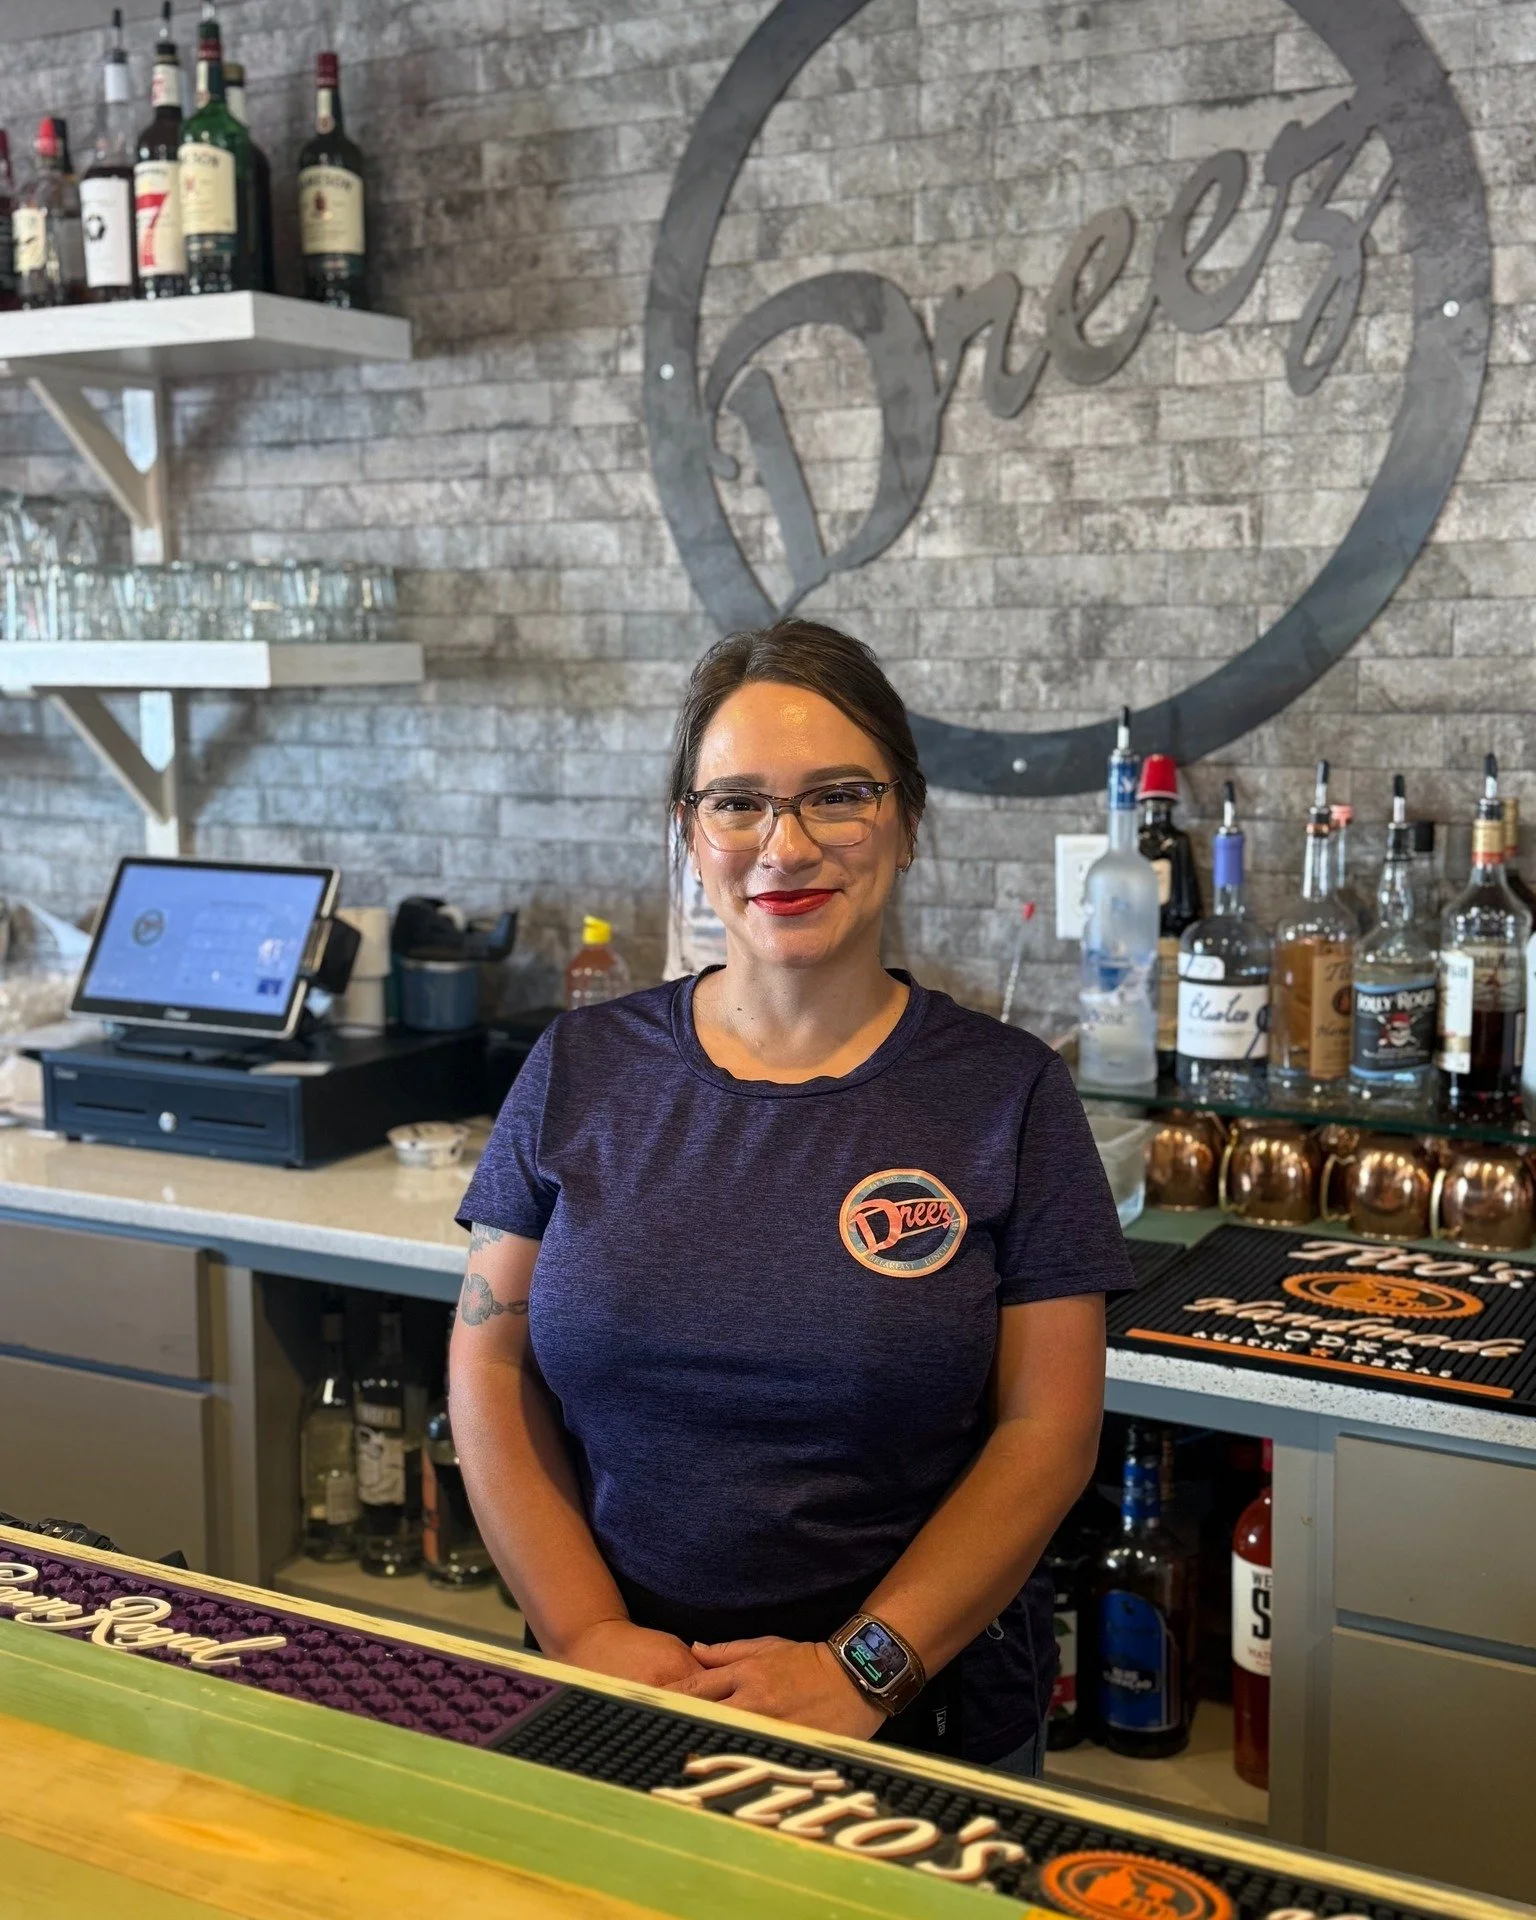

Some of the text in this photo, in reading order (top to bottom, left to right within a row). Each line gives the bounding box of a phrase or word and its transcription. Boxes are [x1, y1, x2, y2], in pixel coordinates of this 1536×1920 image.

[135, 192, 170, 267] 7
[924, 1243, 950, 1266] LUNCH
[1287, 1239, 1535, 1288] Tito's
[1183, 1297, 1526, 1357] Handmade
[1192, 1330, 1452, 1378] AUSTIN TEXAS
[1254, 1324, 1414, 1360] VODKA
[15, 1596, 287, 1668] Royal
[650, 1755, 1026, 1880] Tito's
